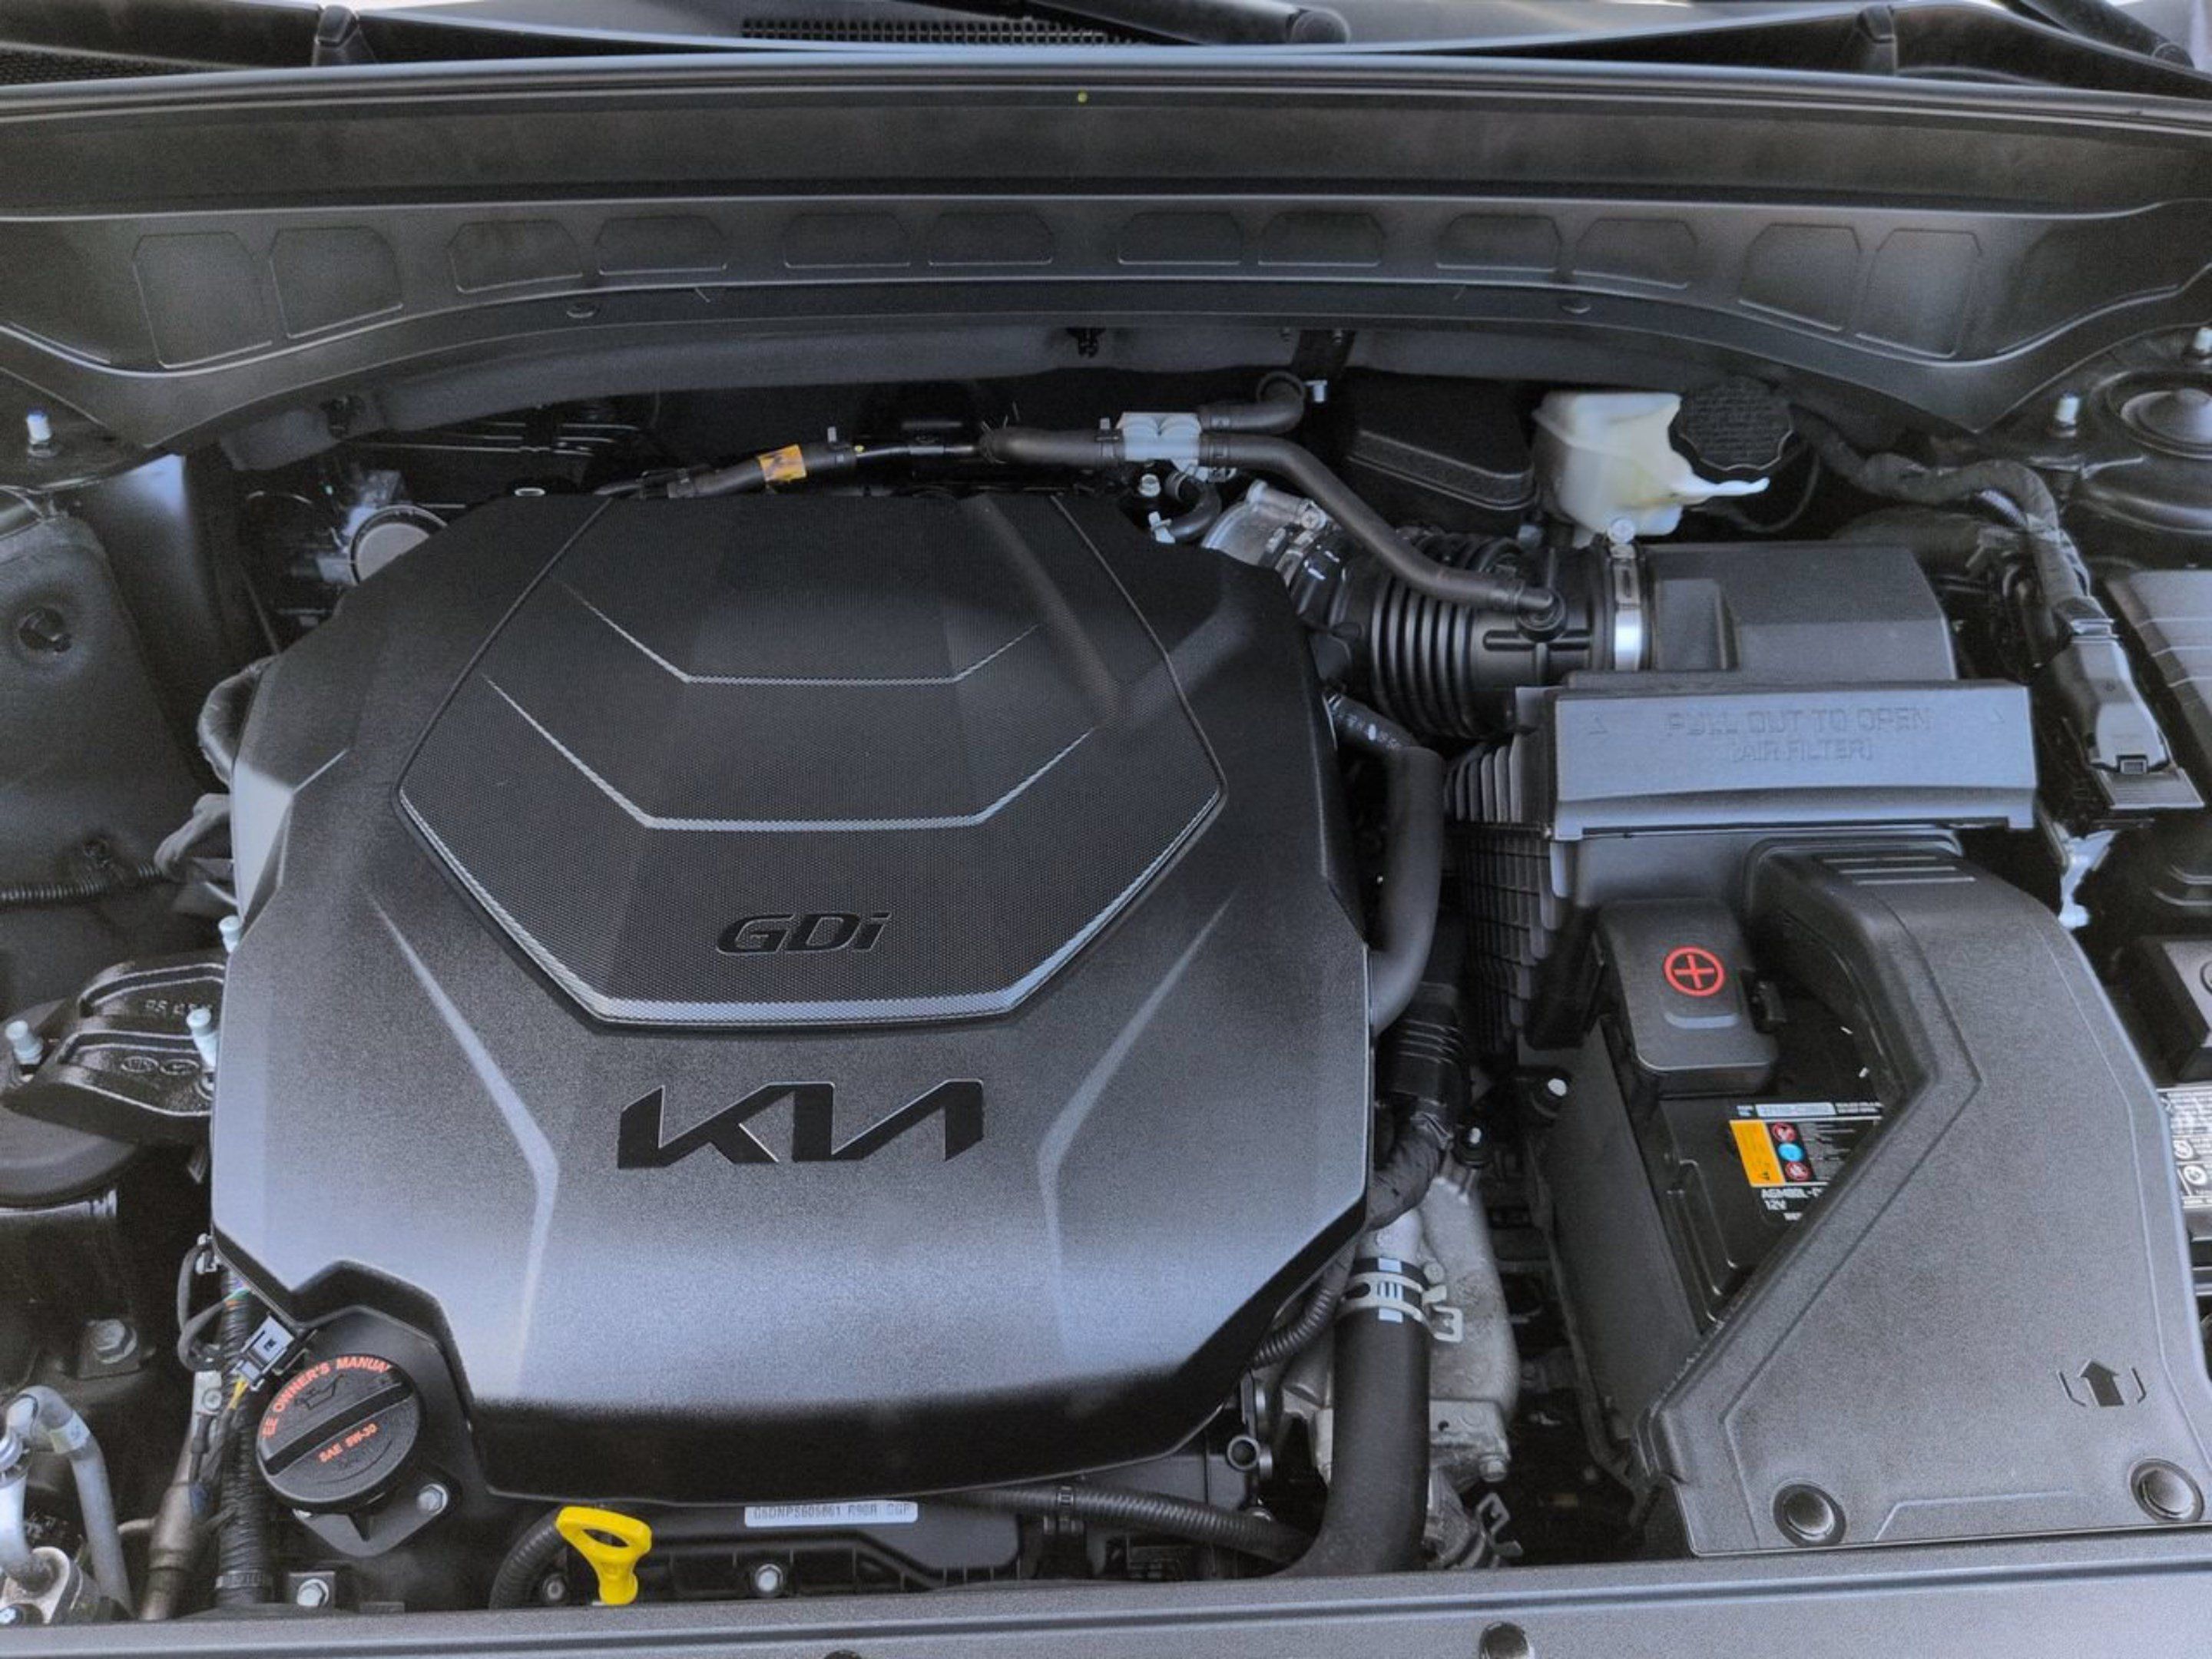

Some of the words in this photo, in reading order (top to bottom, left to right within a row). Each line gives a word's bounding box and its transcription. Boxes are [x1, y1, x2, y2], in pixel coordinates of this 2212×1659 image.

[1665, 710, 1737, 737] PULL
[1747, 708, 1803, 734] OUT
[1810, 707, 1848, 733] TO
[1856, 706, 1933, 733] OPEN
[716, 912, 892, 955] GDi
[618, 1079, 984, 1169] KIA
[273, 1362, 330, 1412] OWNER'S
[319, 1442, 343, 1463] SAE
